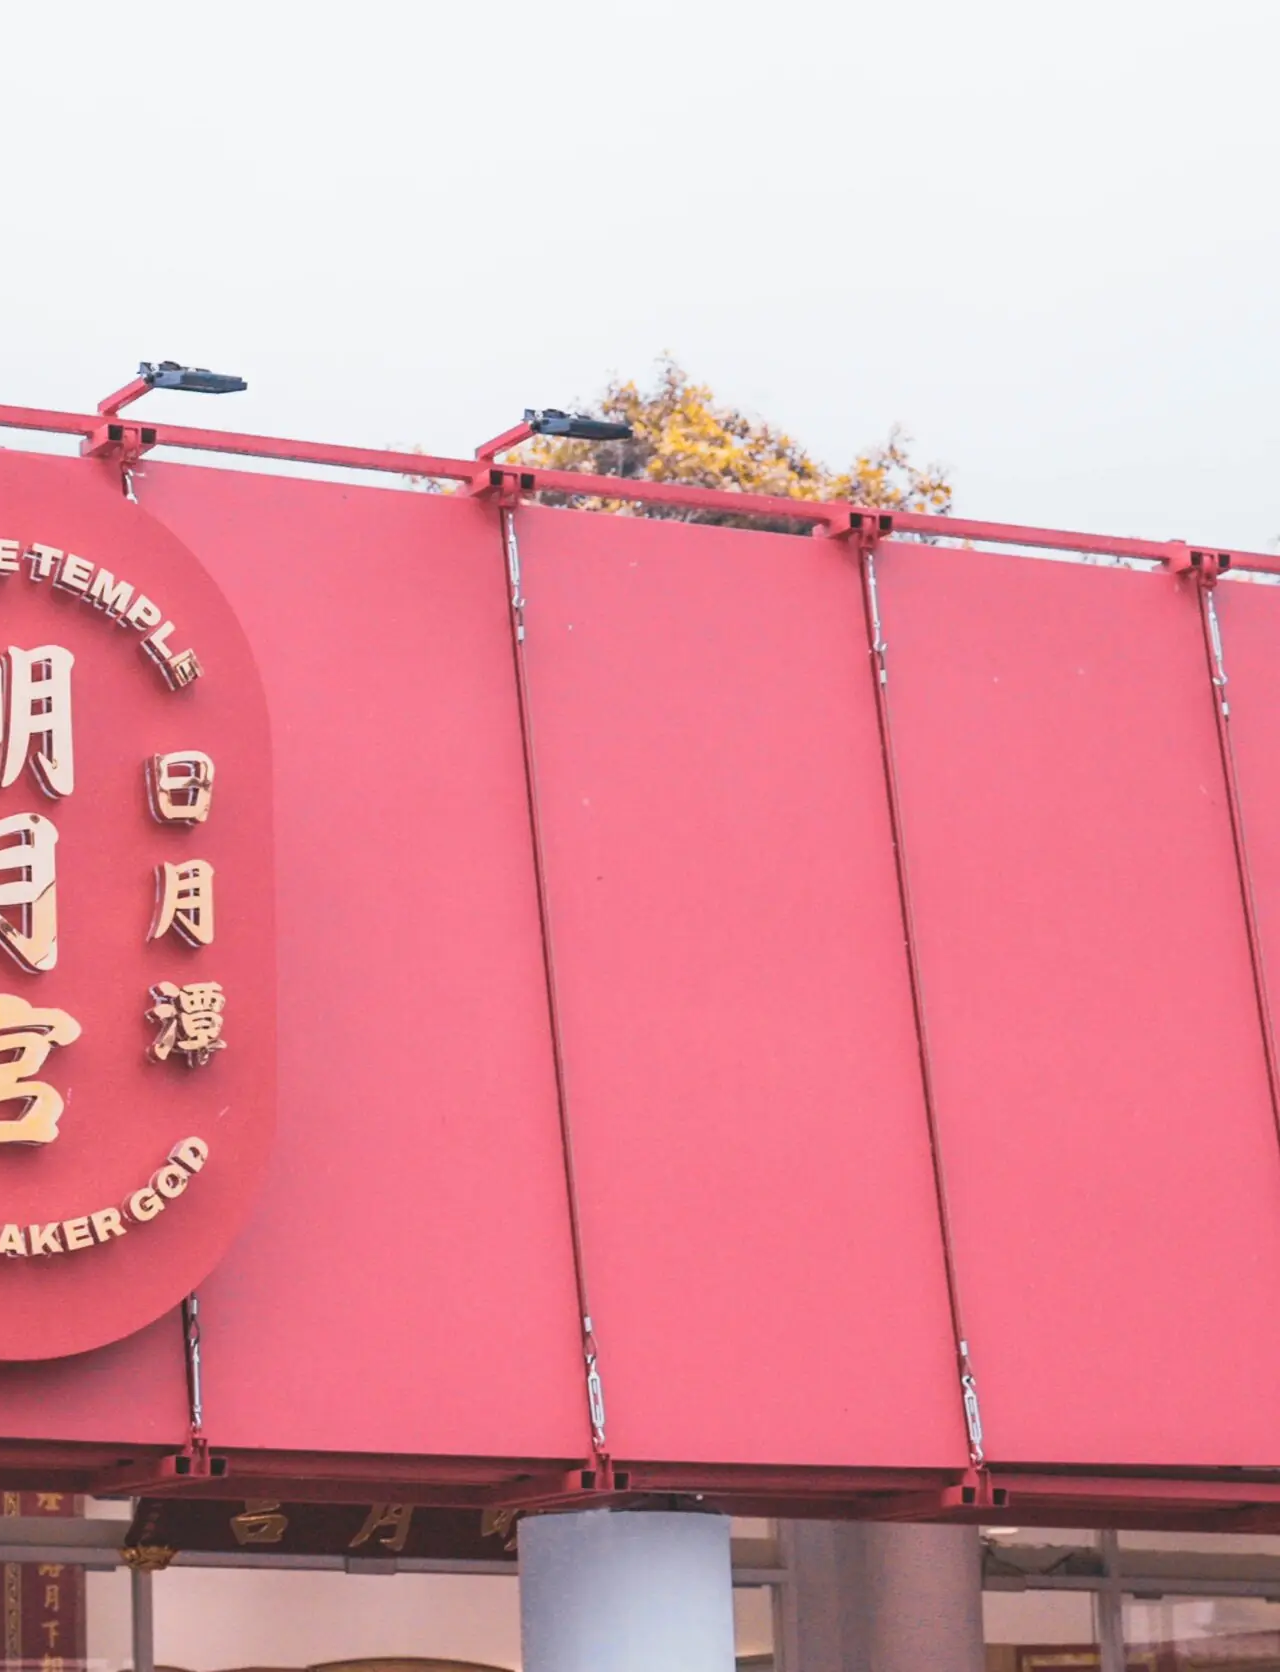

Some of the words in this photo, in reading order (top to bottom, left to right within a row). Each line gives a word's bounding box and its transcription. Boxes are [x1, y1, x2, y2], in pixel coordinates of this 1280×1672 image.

[23, 542, 203, 691] TEMPLE
[144, 750, 226, 1067] 日月潭
[123, 1135, 210, 1223] GOD
